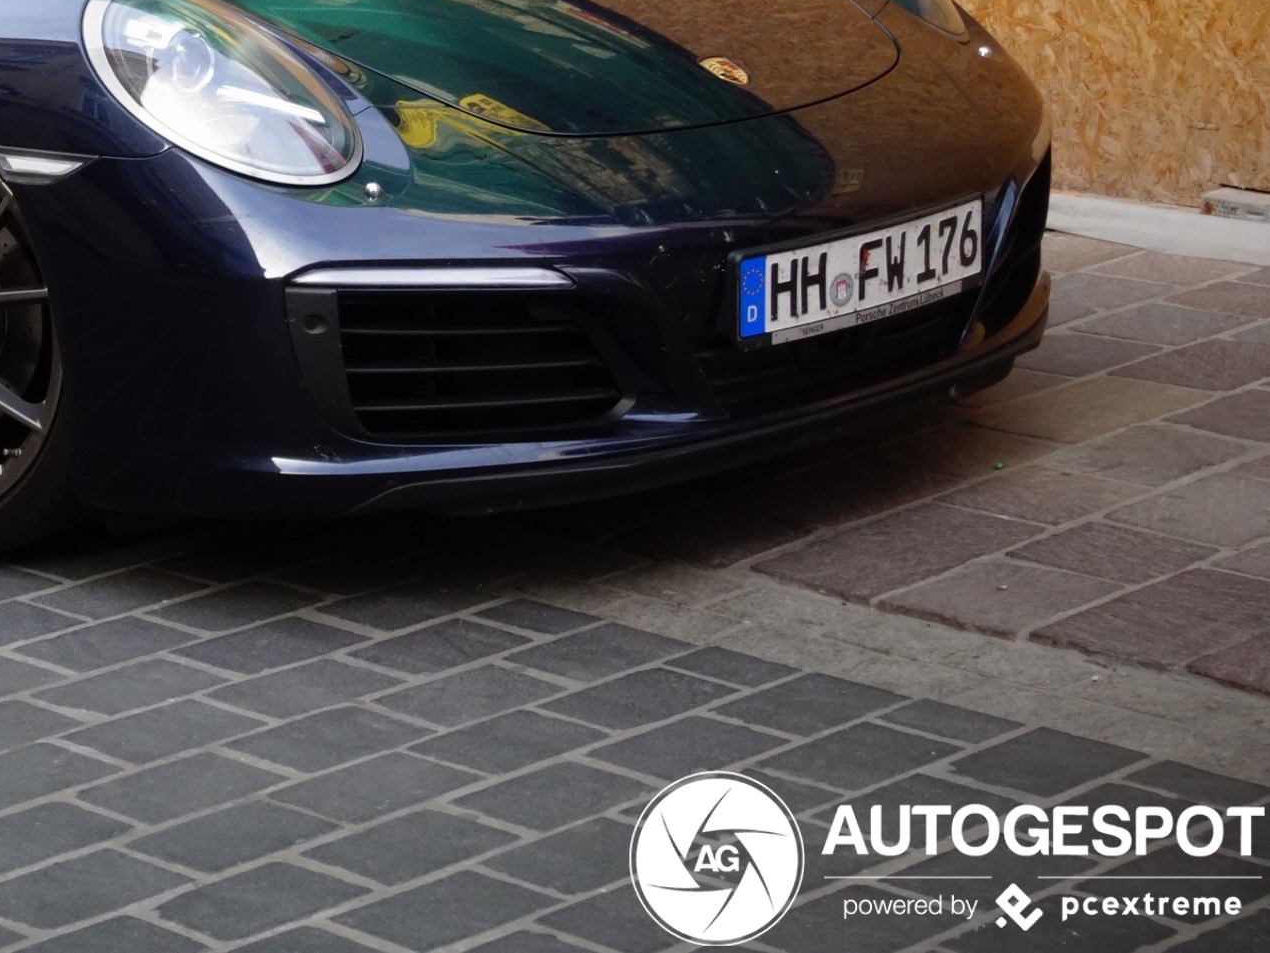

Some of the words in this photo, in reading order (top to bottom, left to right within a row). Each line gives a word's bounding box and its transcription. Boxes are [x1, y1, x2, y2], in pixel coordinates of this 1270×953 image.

[770, 252, 827, 322] HH
[858, 231, 906, 301] FW
[916, 210, 978, 283] 176
[747, 304, 758, 323] D
[855, 306, 887, 324] Porsche
[888, 298, 919, 315] Zentrum
[920, 287, 944, 305] Lübeck
